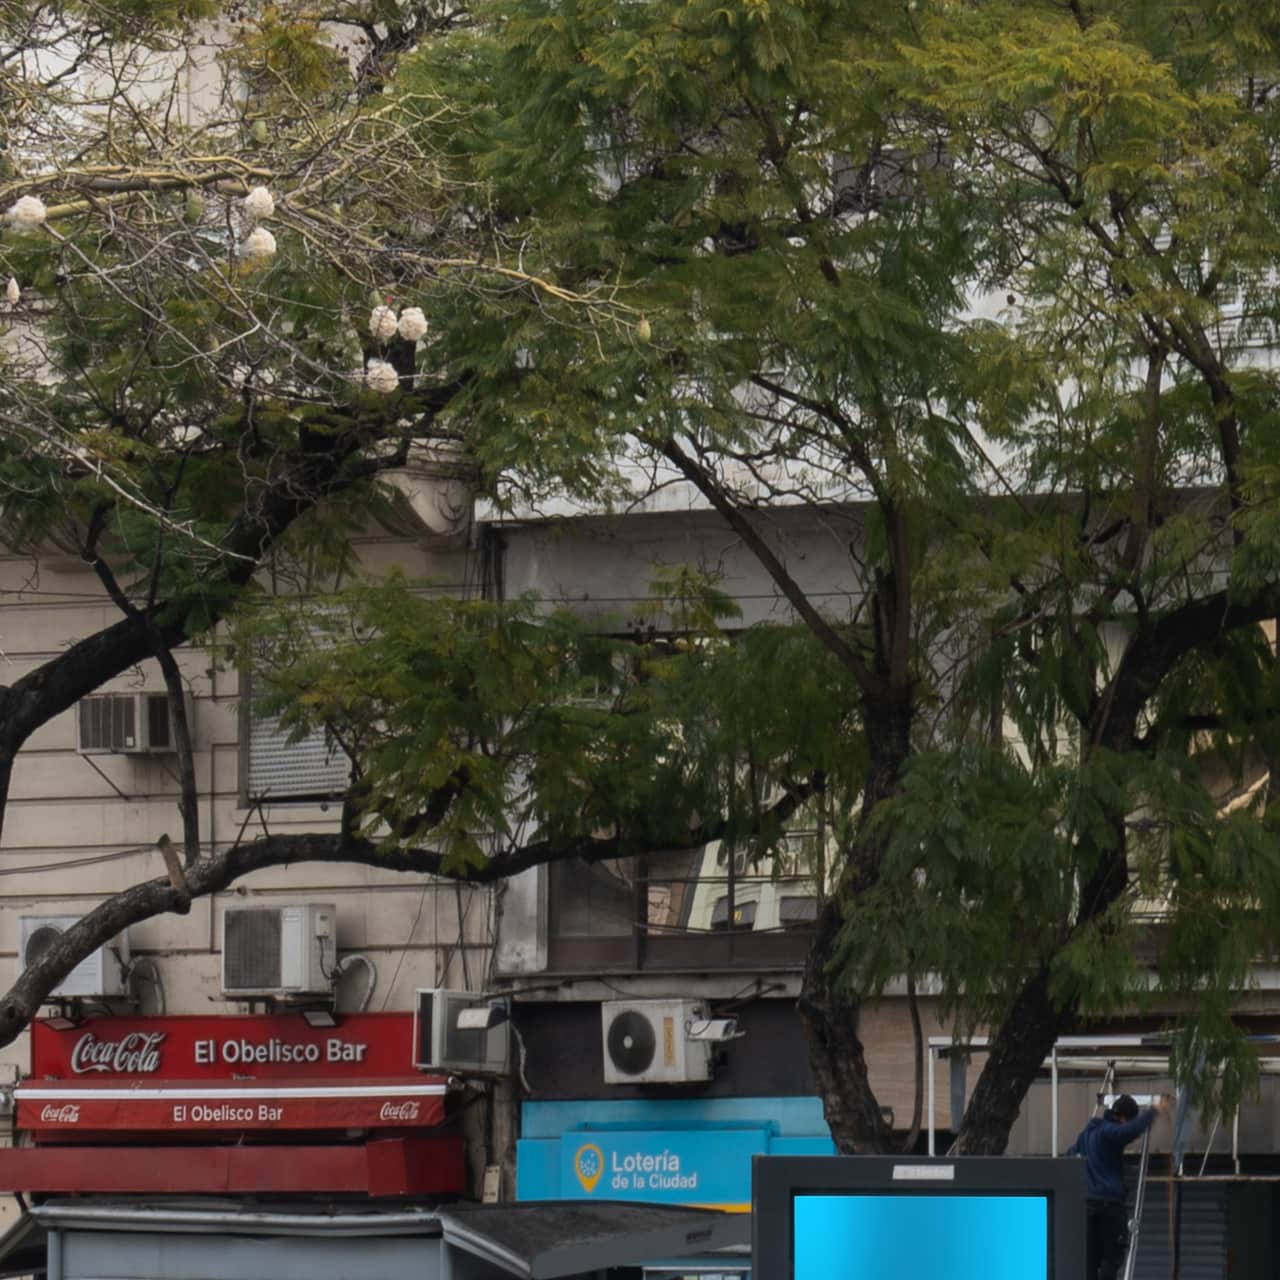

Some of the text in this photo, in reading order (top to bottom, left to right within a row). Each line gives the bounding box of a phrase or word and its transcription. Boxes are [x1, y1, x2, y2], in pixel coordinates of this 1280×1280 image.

[194, 1038, 367, 1064] El Obelisco Bar
[173, 1105, 283, 1122] El Obelisco Bar
[612, 1149, 680, 1172] Lotería
[612, 1171, 697, 1190] de la Ciudad
